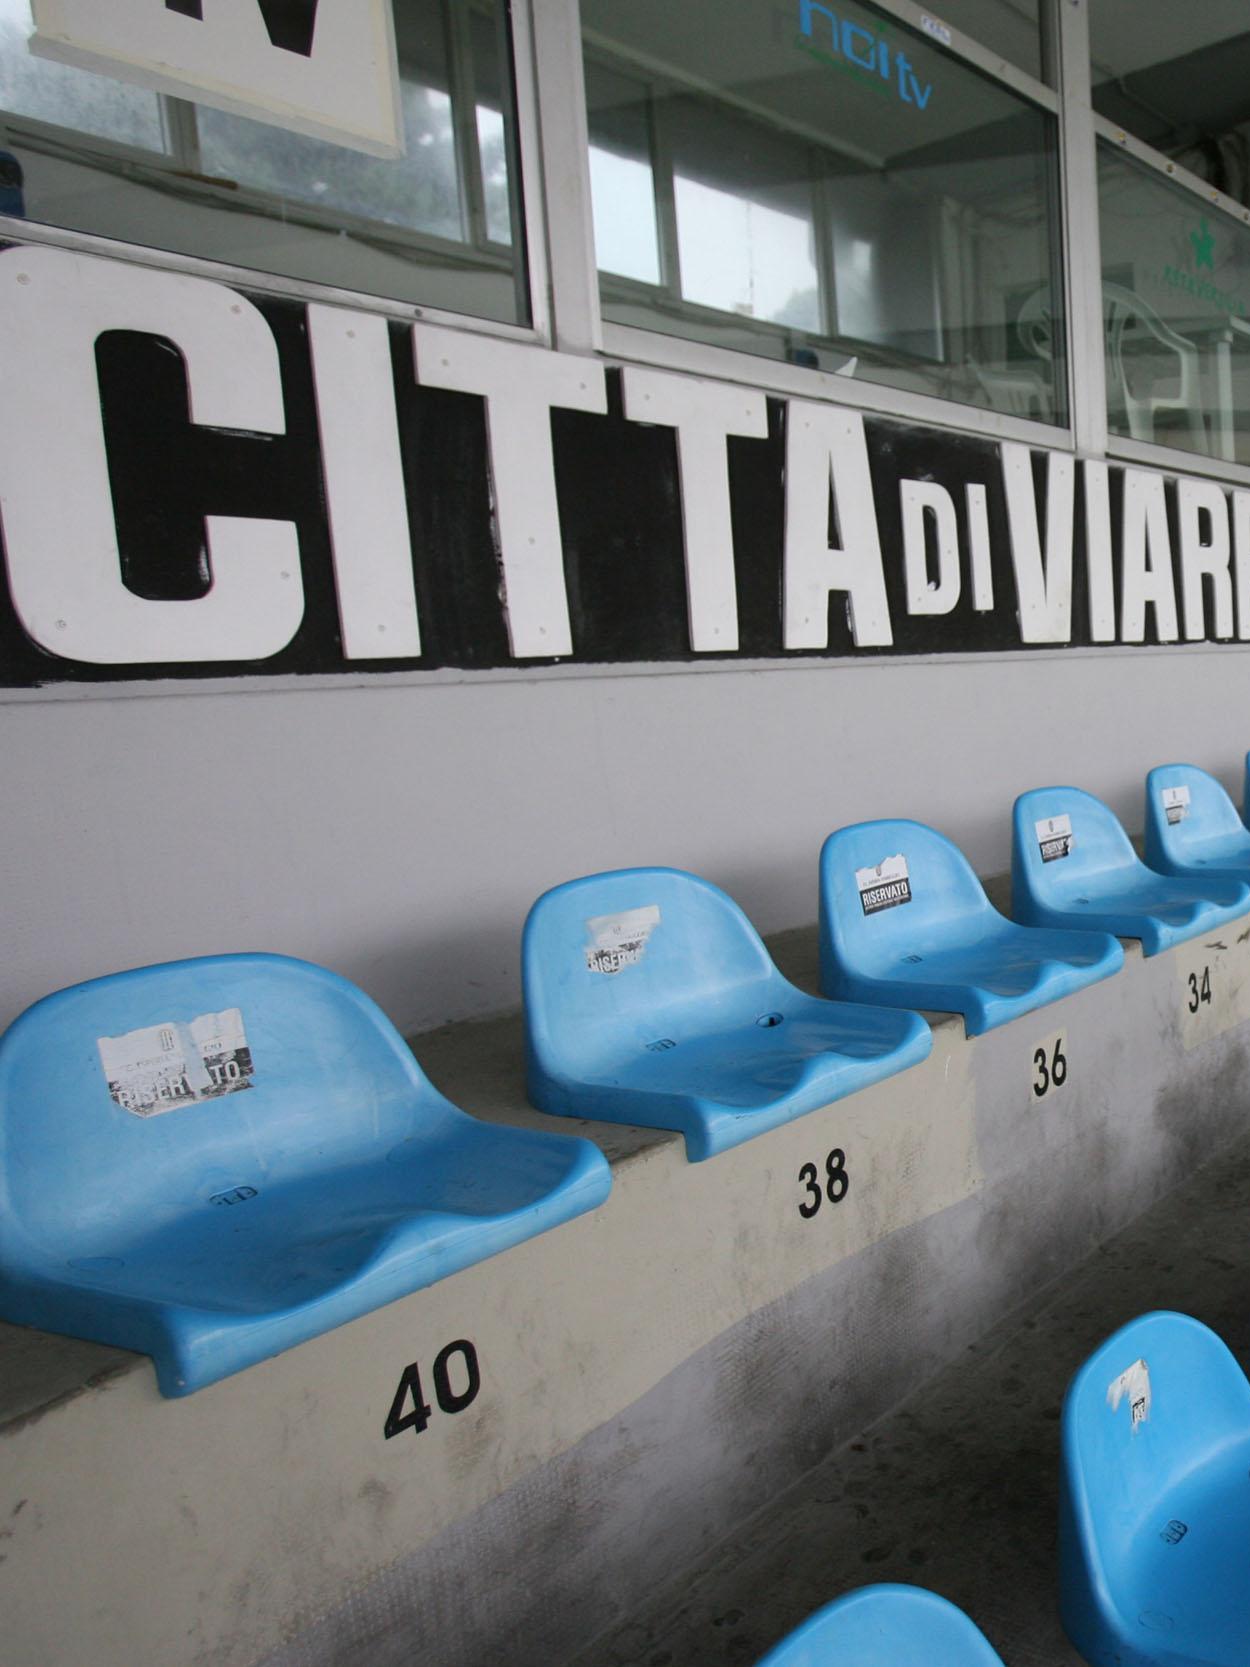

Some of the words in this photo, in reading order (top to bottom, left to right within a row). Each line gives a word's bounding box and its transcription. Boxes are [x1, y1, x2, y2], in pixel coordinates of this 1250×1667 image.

[0, 244, 893, 664] CITTA
[899, 478, 994, 616] DI
[862, 881, 909, 906] RISERVATO
[1188, 966, 1211, 1014] 34
[1033, 1038, 1067, 1097] 36
[799, 1148, 849, 1219] 38
[384, 1339, 481, 1440] 40
